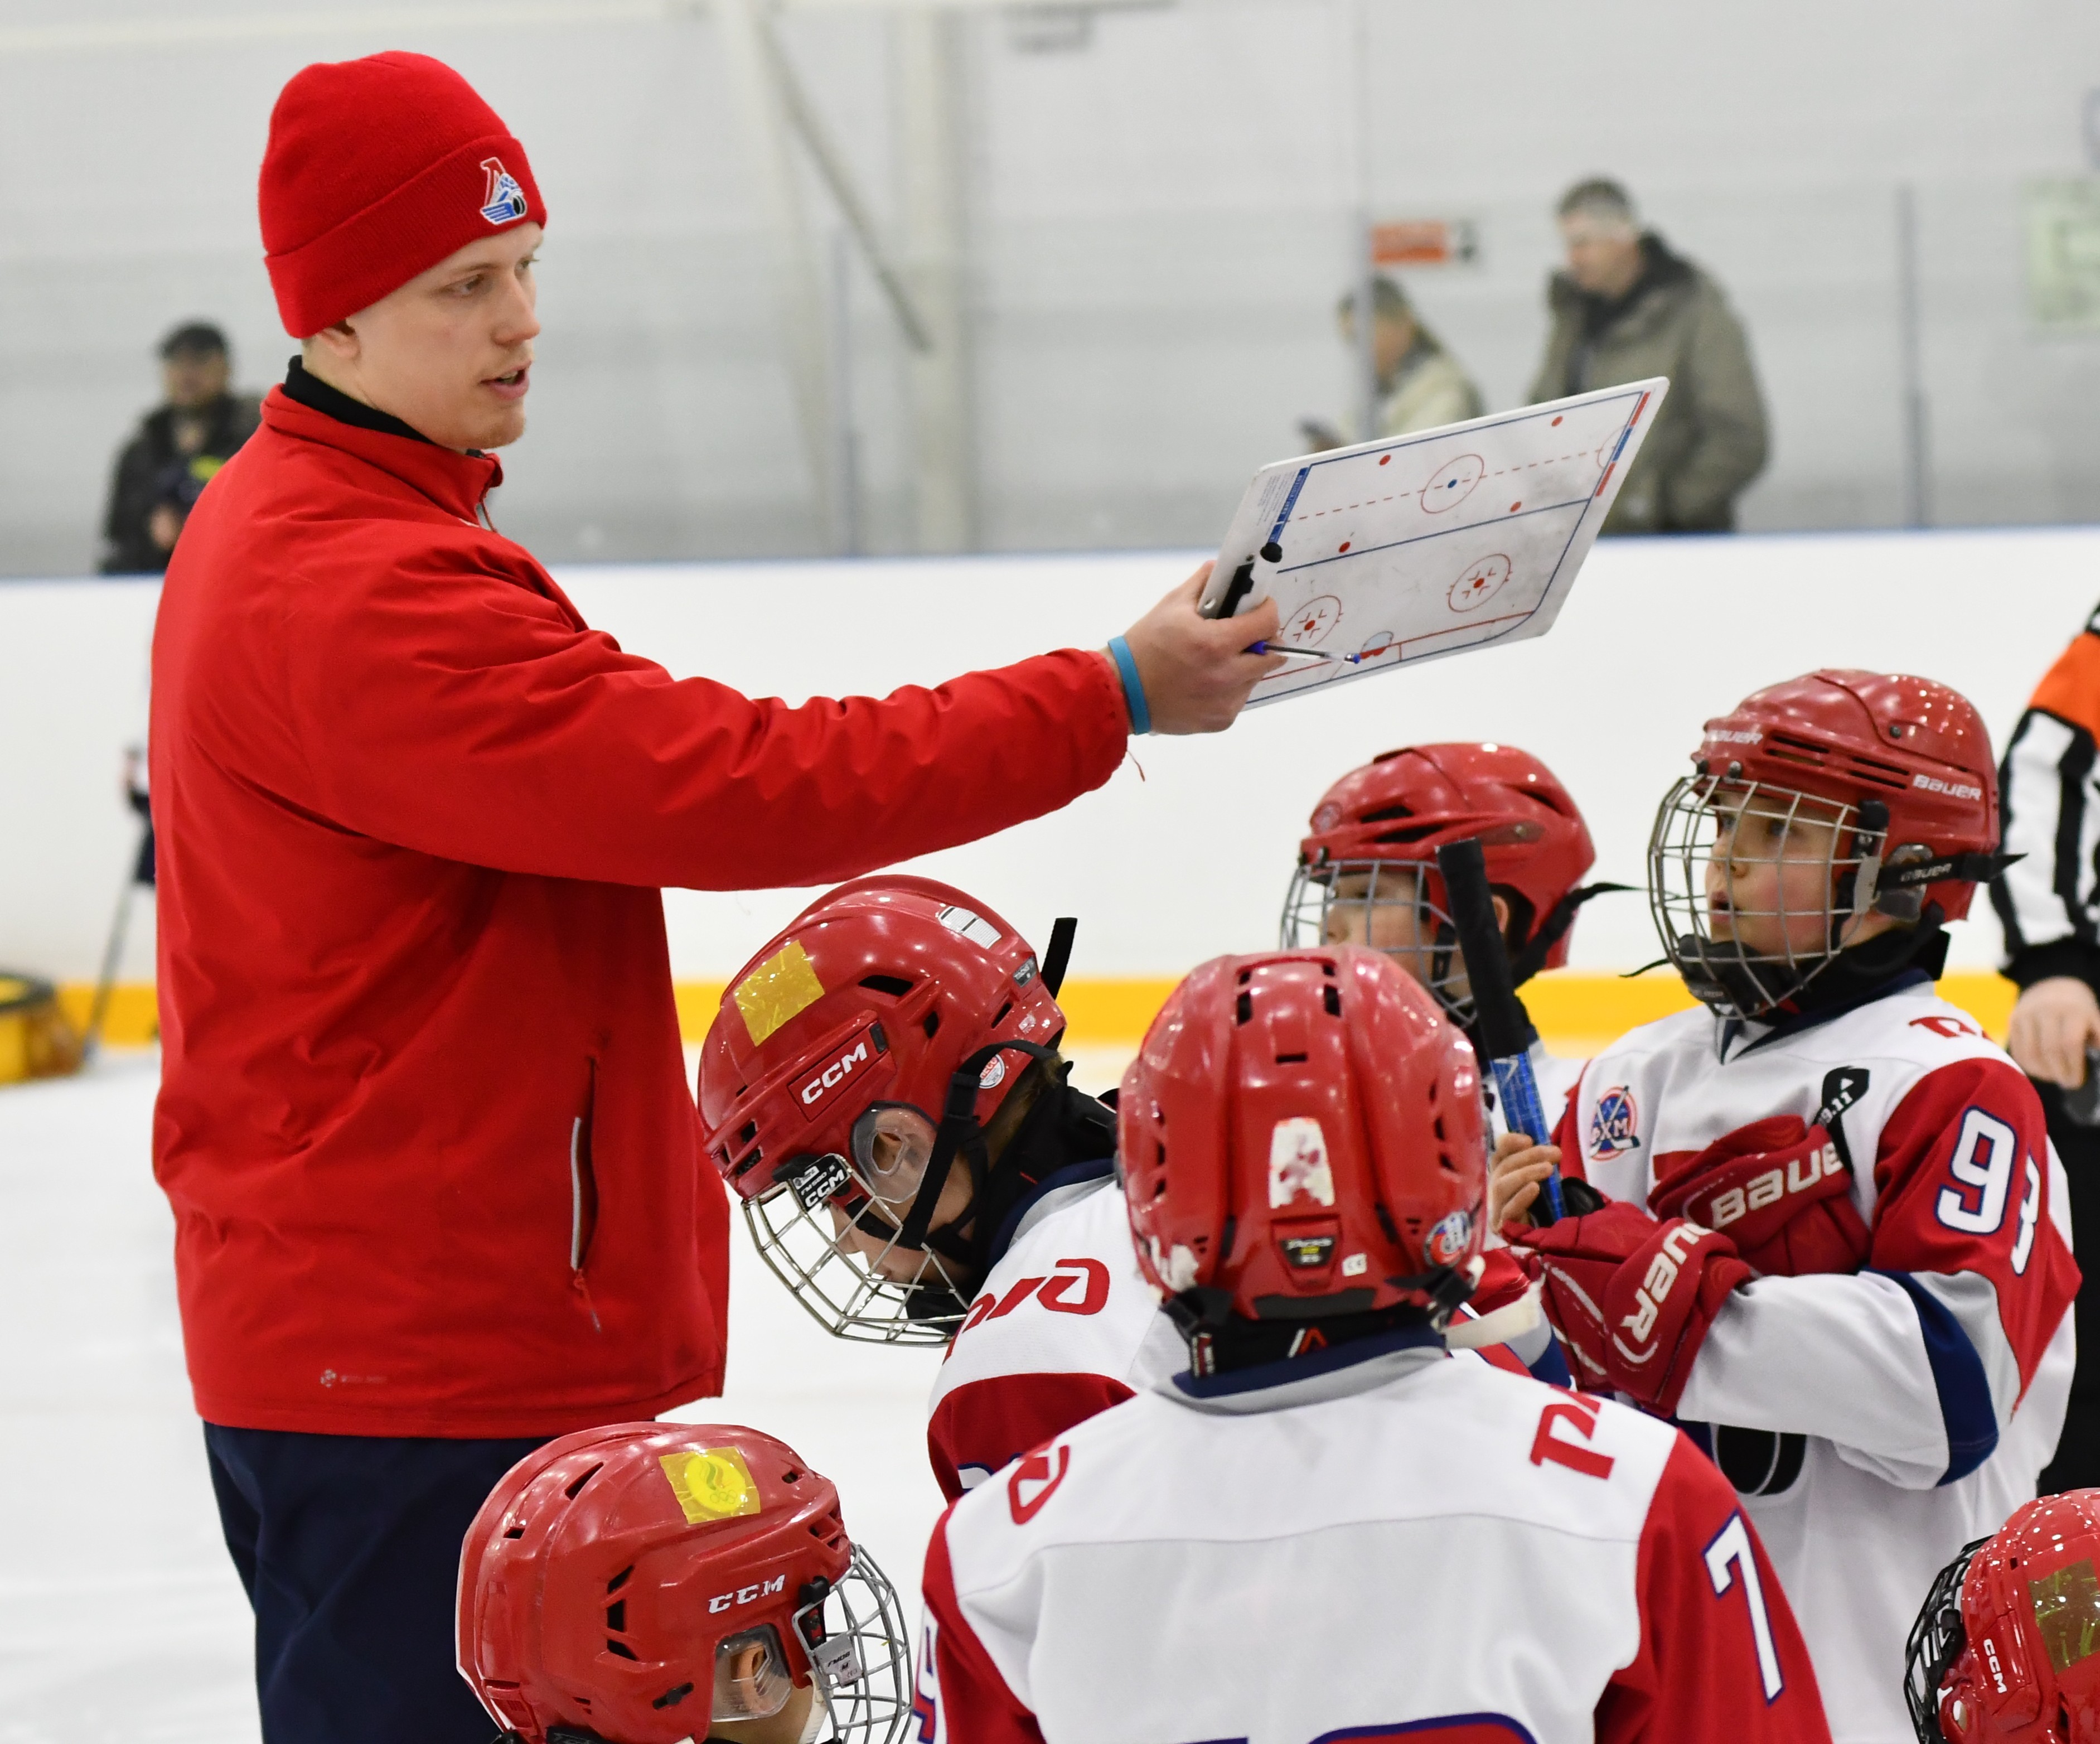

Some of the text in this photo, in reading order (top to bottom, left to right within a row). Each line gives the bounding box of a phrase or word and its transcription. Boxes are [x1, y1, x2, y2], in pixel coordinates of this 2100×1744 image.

[1913, 774, 1982, 801] BAUER
[801, 1042, 868, 1104] CCM
[1818, 1091, 1853, 1125] 9.11
[805, 1168, 845, 1207] CCM
[1710, 1141, 1844, 1230] BAUE
[1620, 1223, 1712, 1344] UER
[708, 1574, 786, 1614] CCM
[1704, 1508, 1784, 1706] 7
[1983, 1639, 2007, 1693] CCM
